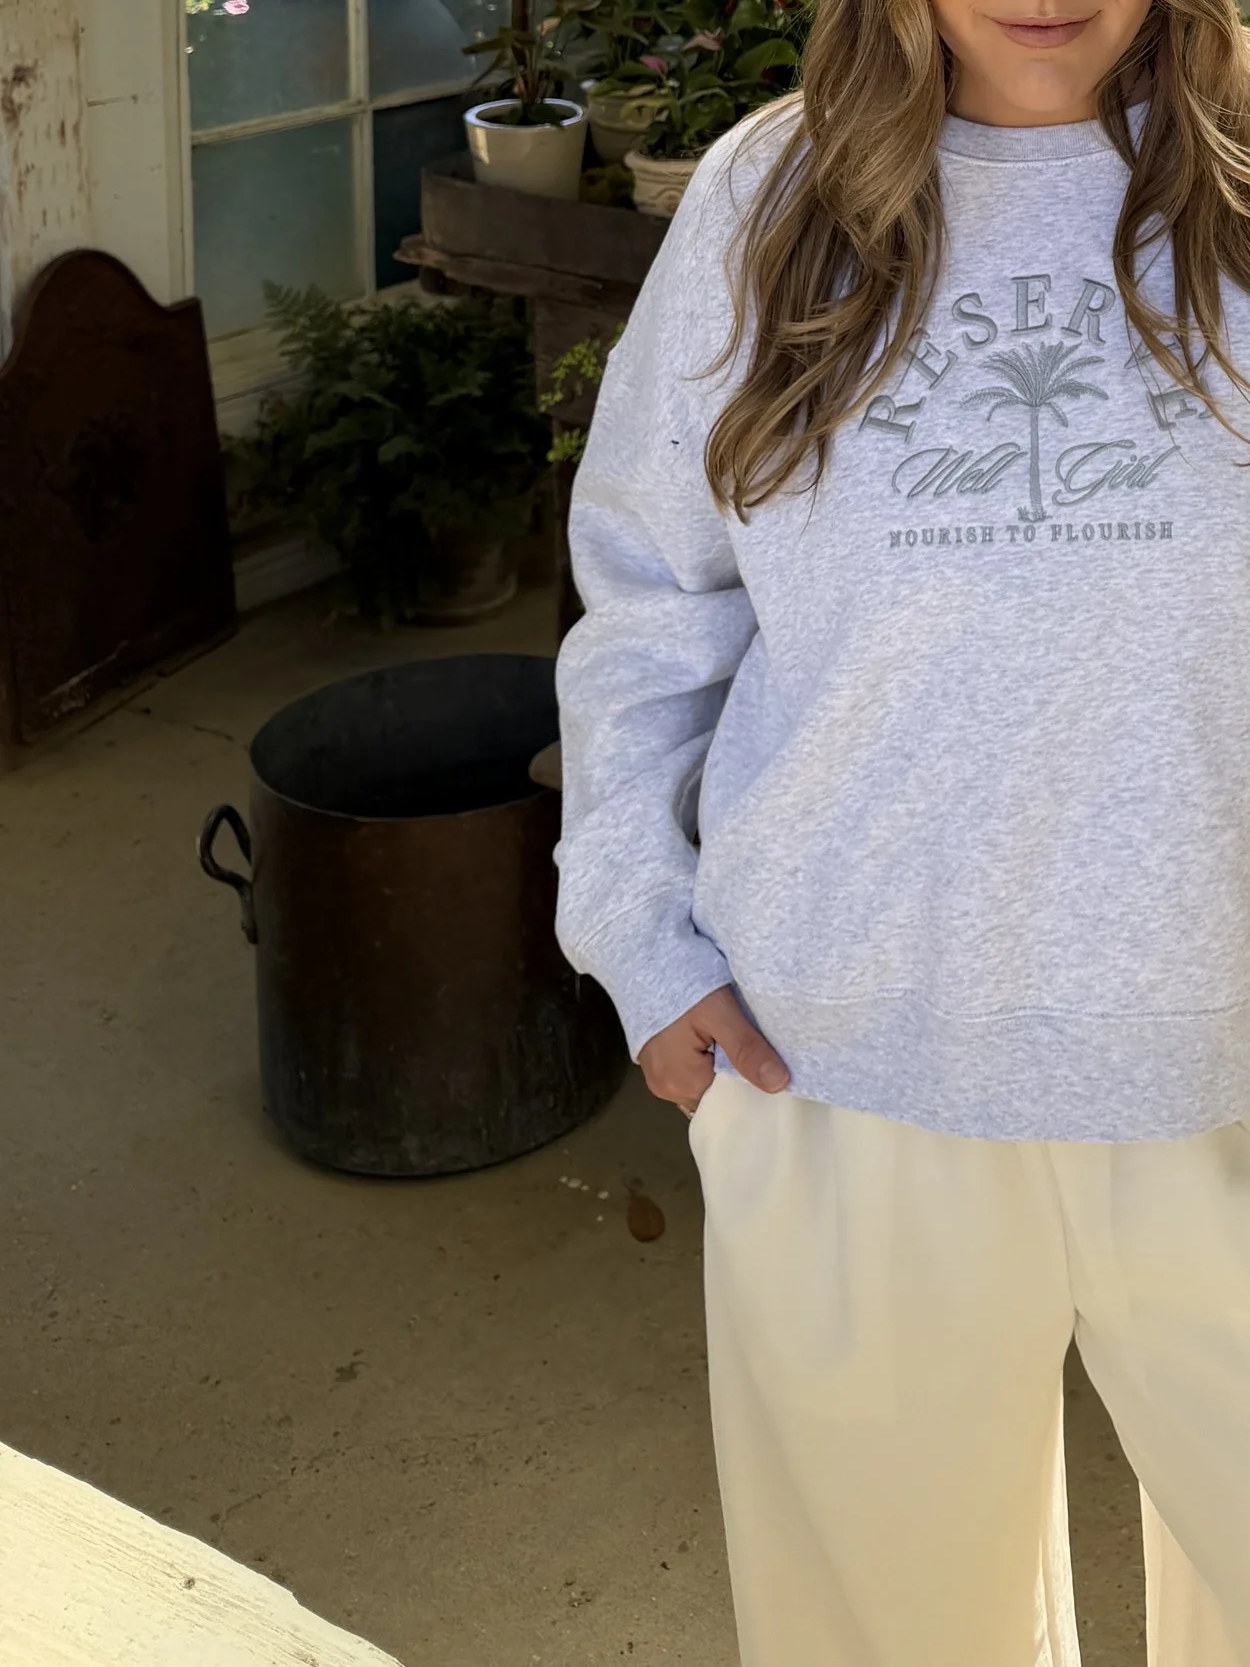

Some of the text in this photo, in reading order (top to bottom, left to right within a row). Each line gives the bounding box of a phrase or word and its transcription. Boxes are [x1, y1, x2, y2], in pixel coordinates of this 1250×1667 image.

[891, 439, 1181, 506] Well Girl
[889, 521, 1174, 548] NOURISH TO FLOURISH
